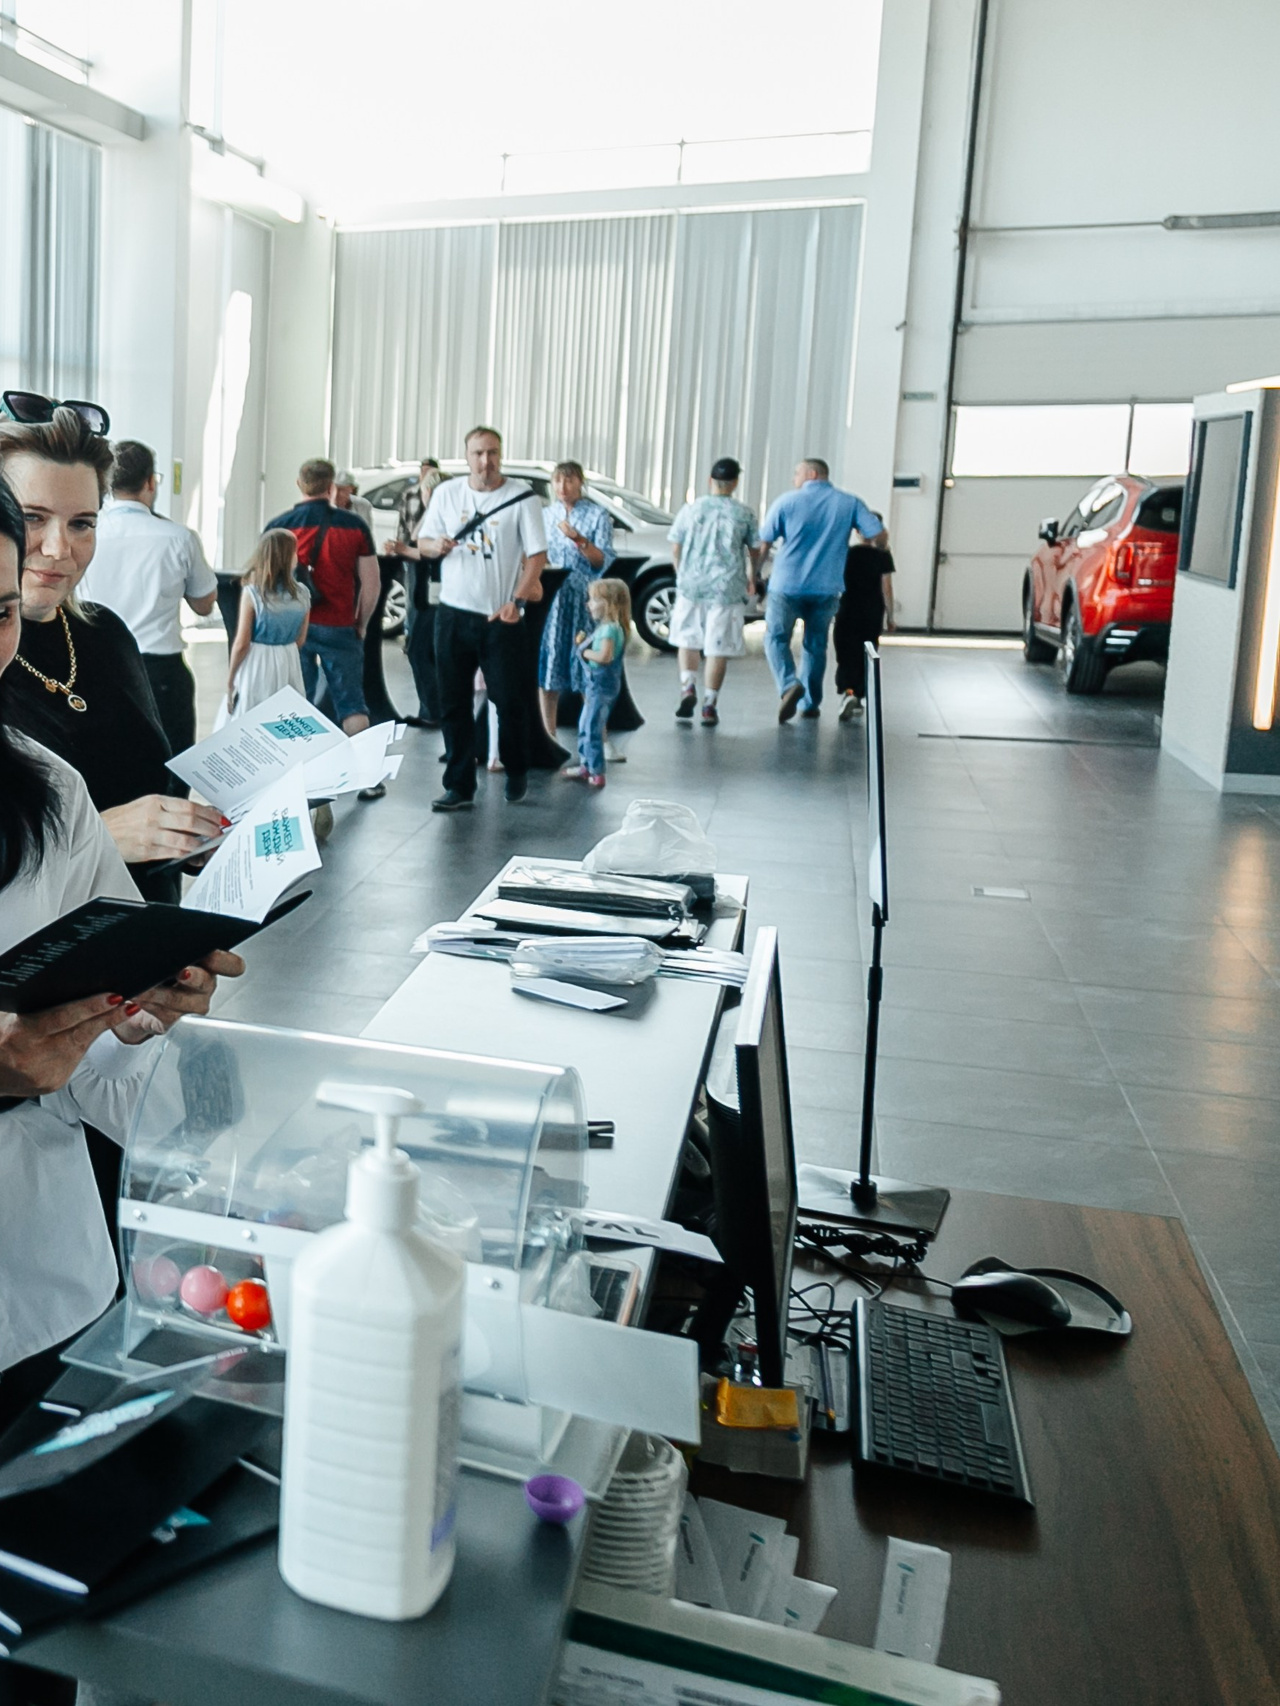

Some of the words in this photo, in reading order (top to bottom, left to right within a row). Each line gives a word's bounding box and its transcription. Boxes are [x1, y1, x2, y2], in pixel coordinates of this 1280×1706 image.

[274, 724, 296, 742] ДЕНЬ
[277, 713, 313, 743] КАЖДЫЙ
[288, 711, 316, 736] ВАЖЕН
[272, 809, 286, 866] КАЖДЫЙ
[280, 807, 294, 851] ВАЖЕН
[261, 829, 271, 862] ДЕНЬ
